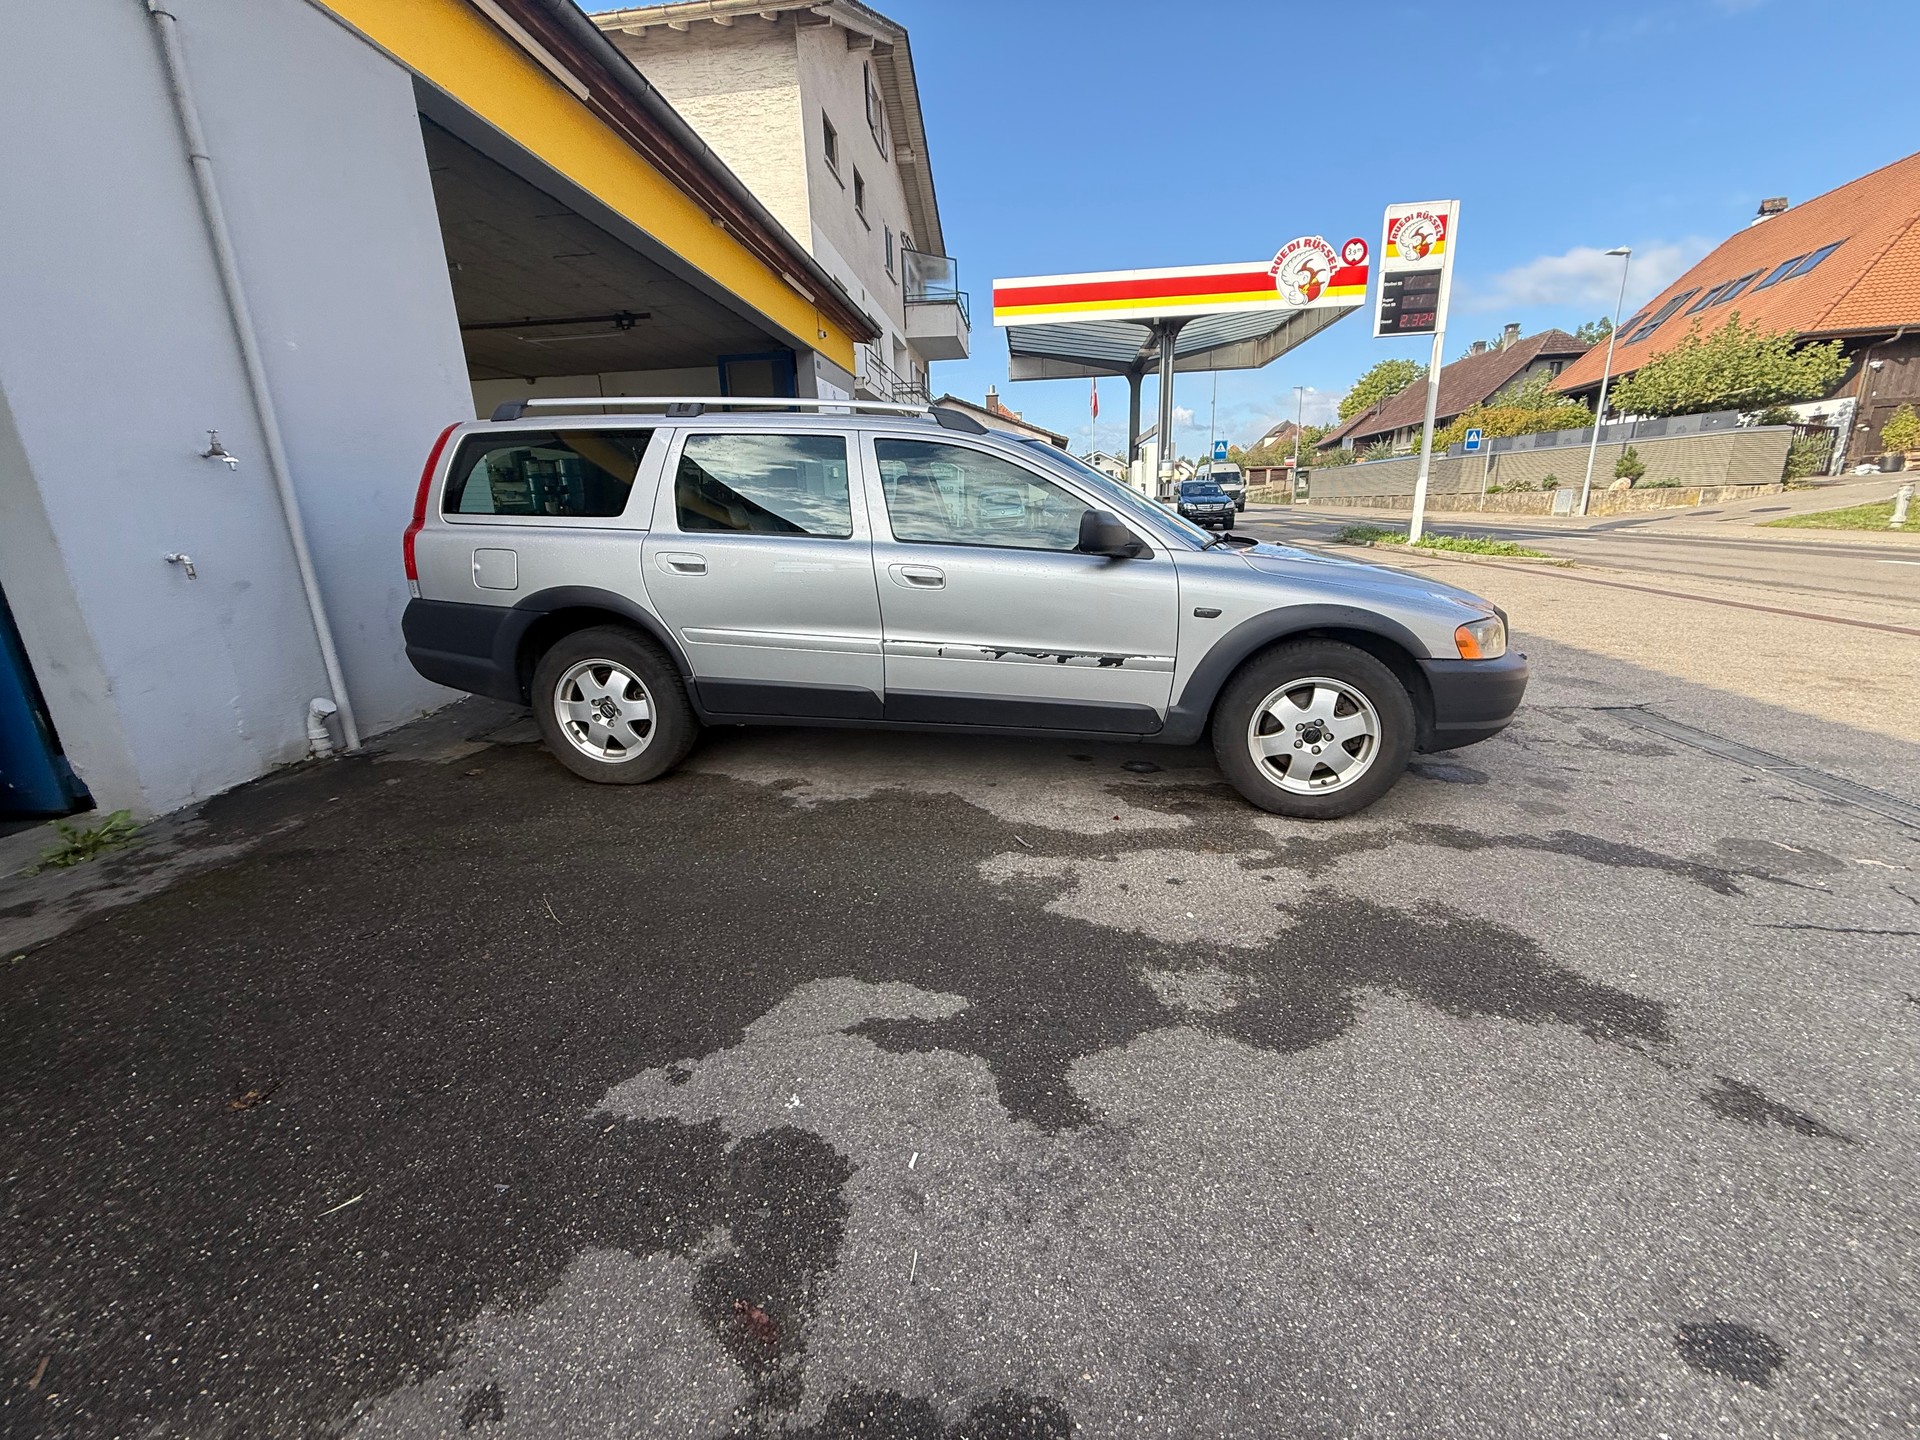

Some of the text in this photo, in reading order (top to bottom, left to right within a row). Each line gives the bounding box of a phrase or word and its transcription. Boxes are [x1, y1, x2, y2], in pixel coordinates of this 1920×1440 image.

[1391, 210, 1442, 239] RUEDI RÜSSEL
[1270, 237, 1338, 275] RUEDI RÜSSEL
